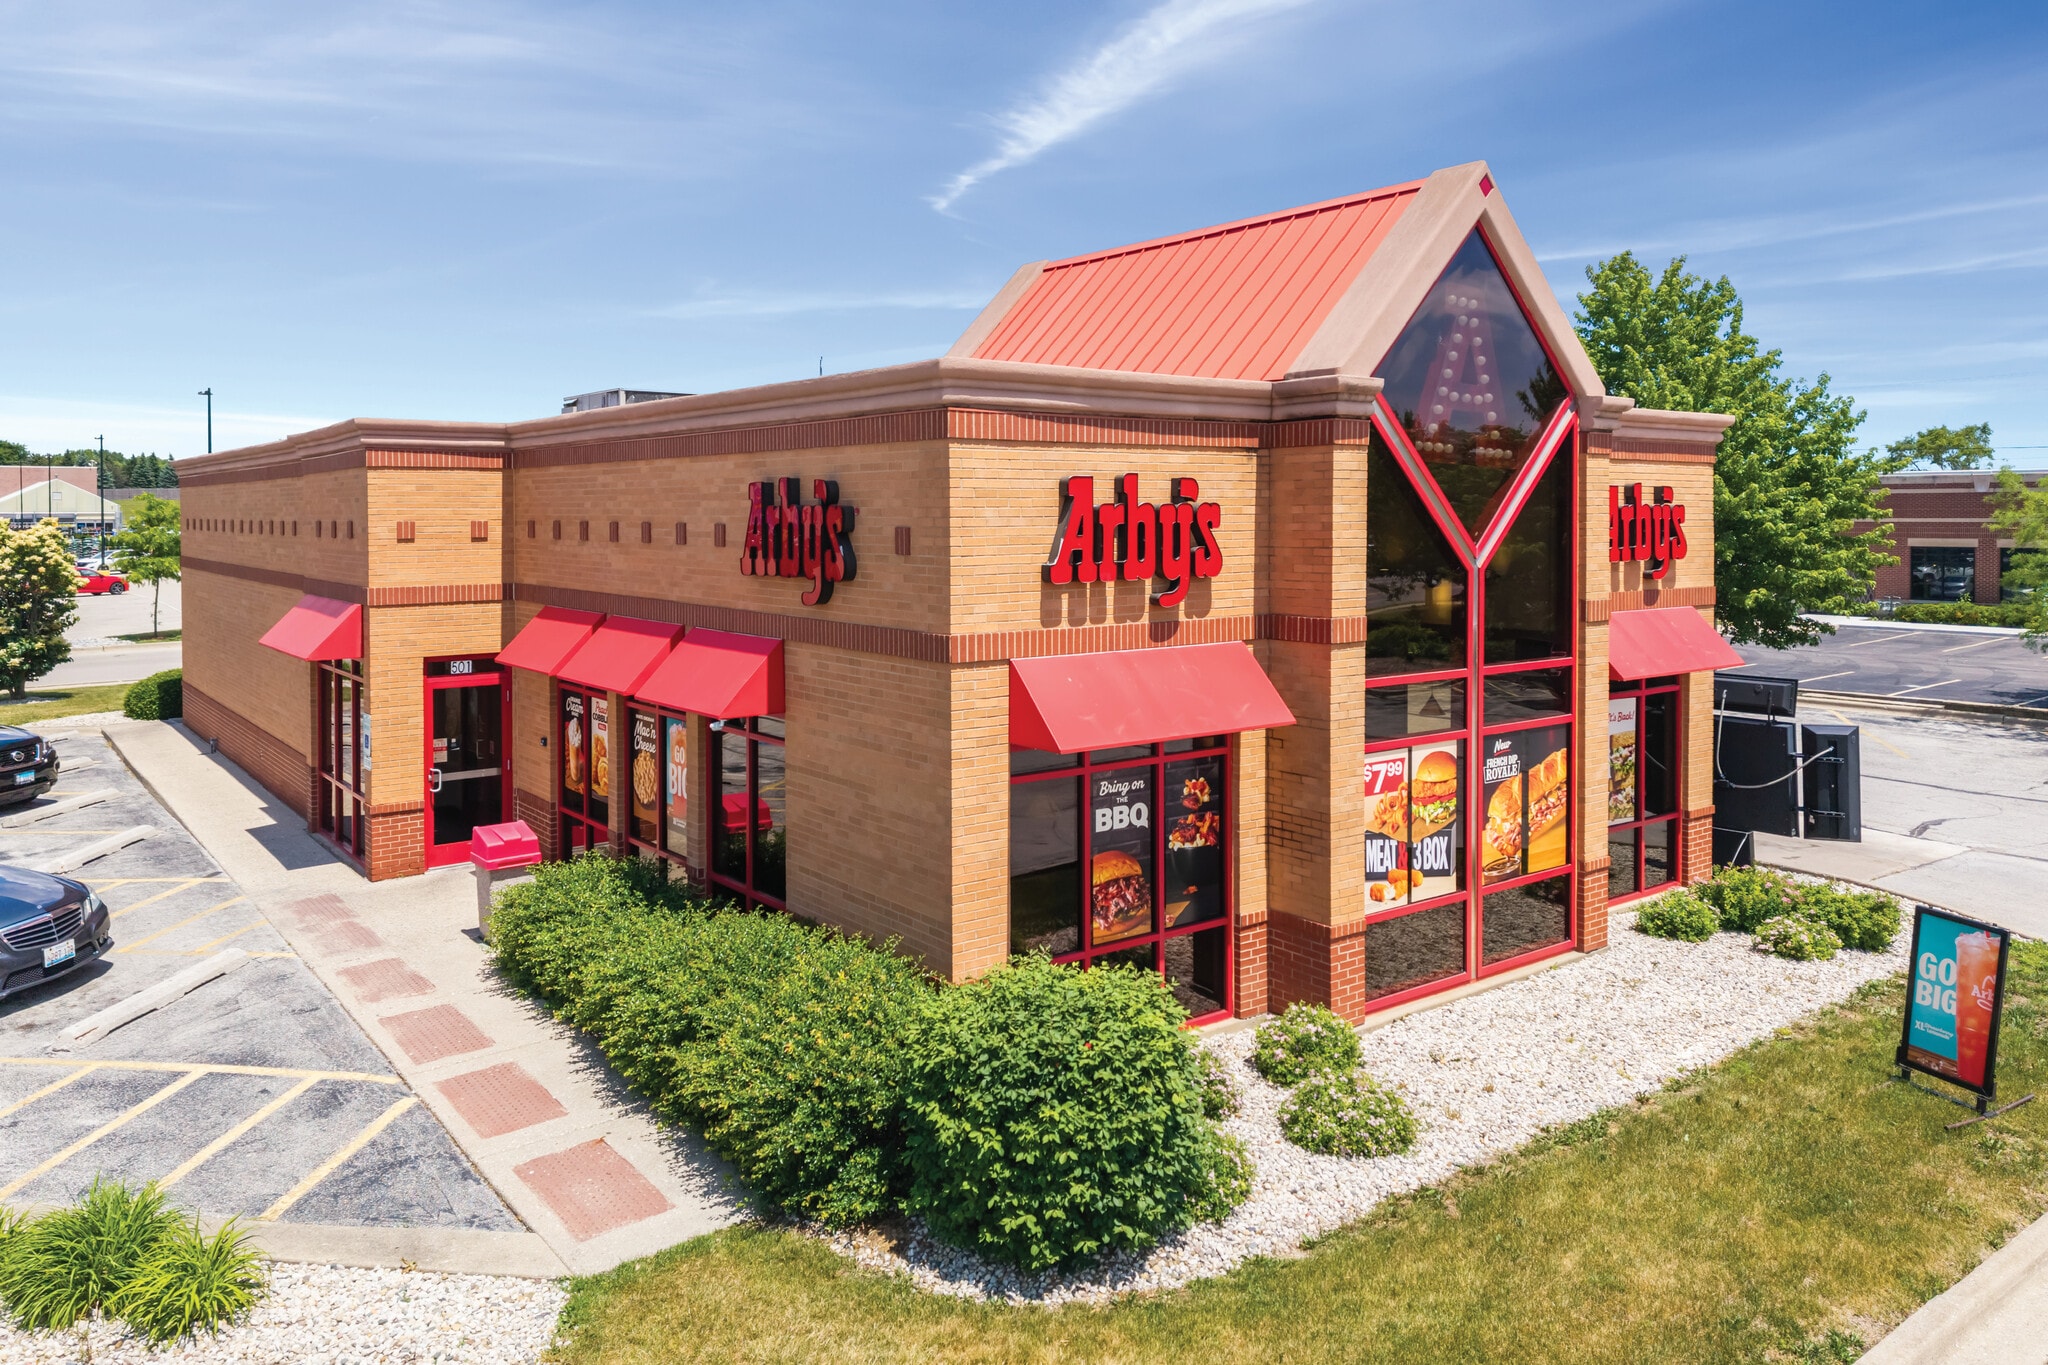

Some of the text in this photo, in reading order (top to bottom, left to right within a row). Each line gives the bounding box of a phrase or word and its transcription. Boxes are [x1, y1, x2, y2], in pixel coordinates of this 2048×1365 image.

[740, 477, 846, 606] Arby's
[1051, 472, 1223, 608] Arby's
[451, 661, 471, 674] 501
[1617, 710, 1635, 722] Back!
[634, 735, 656, 753] Cheese
[1494, 739, 1512, 753] New
[674, 745, 685, 765] GO
[1486, 754, 1518, 768] FRENCH DIP
[1486, 764, 1518, 780] ROYALE
[1100, 778, 1145, 796] Bring on
[1116, 796, 1128, 804] THE
[1095, 802, 1149, 833] BBQ
[1365, 839, 1398, 873] MEAT
[1413, 841, 1422, 871] 3
[1423, 836, 1449, 871] BOX
[1918, 952, 1957, 987] GO
[1915, 979, 1957, 1016] BIG
[1915, 1019, 1926, 1032] XL
